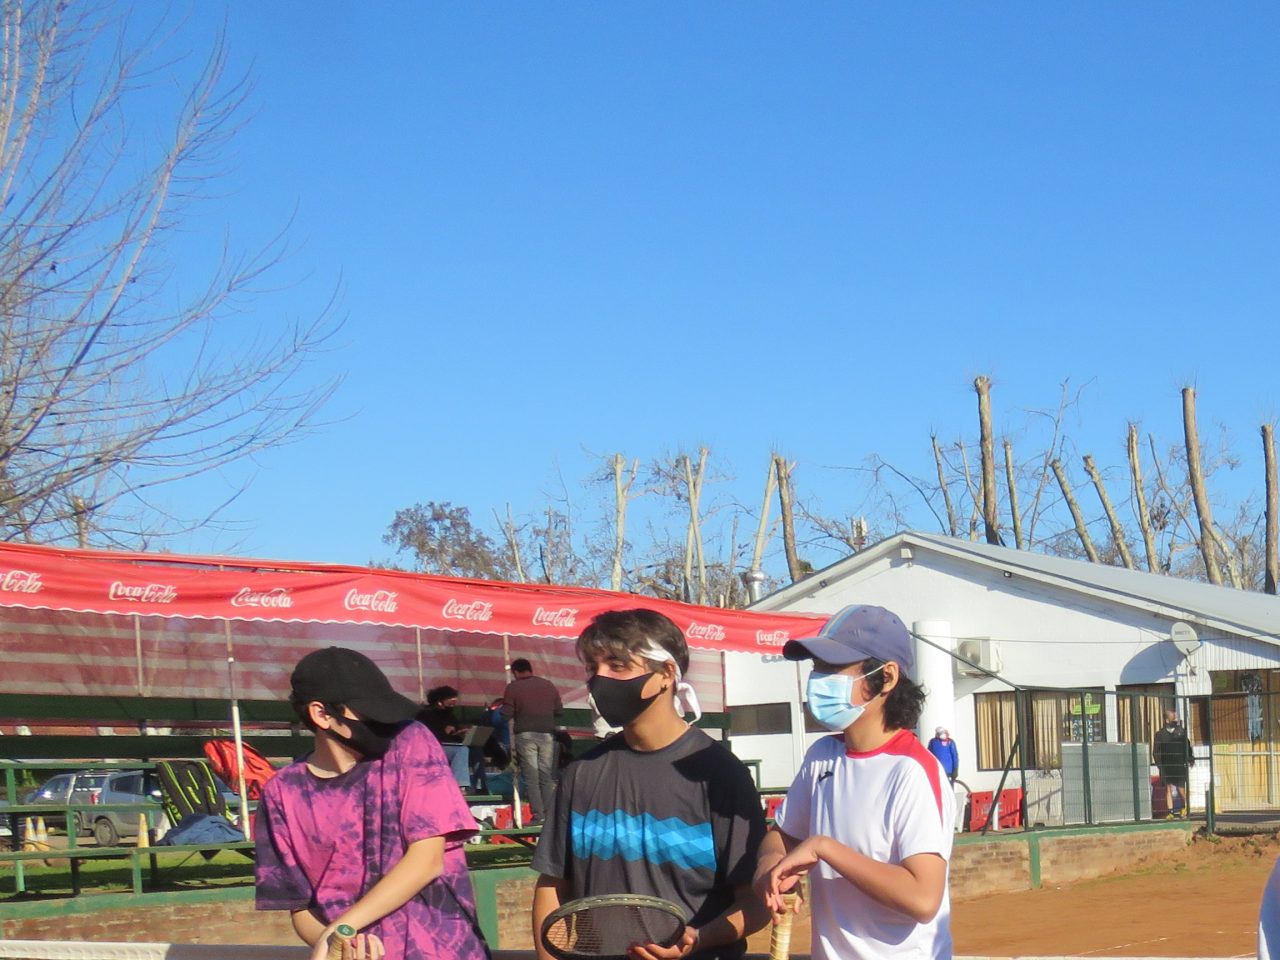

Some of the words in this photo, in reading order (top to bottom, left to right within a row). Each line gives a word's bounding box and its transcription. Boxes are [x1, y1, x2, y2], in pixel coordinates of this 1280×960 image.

[109, 581, 178, 603] Coca-Cola
[231, 586, 294, 608] Coca-Cola
[344, 588, 399, 613] Coca-Cola
[442, 598, 493, 622] Coca-Cola
[532, 606, 579, 628] Coca-Cola
[686, 622, 726, 641] Coca-Cola
